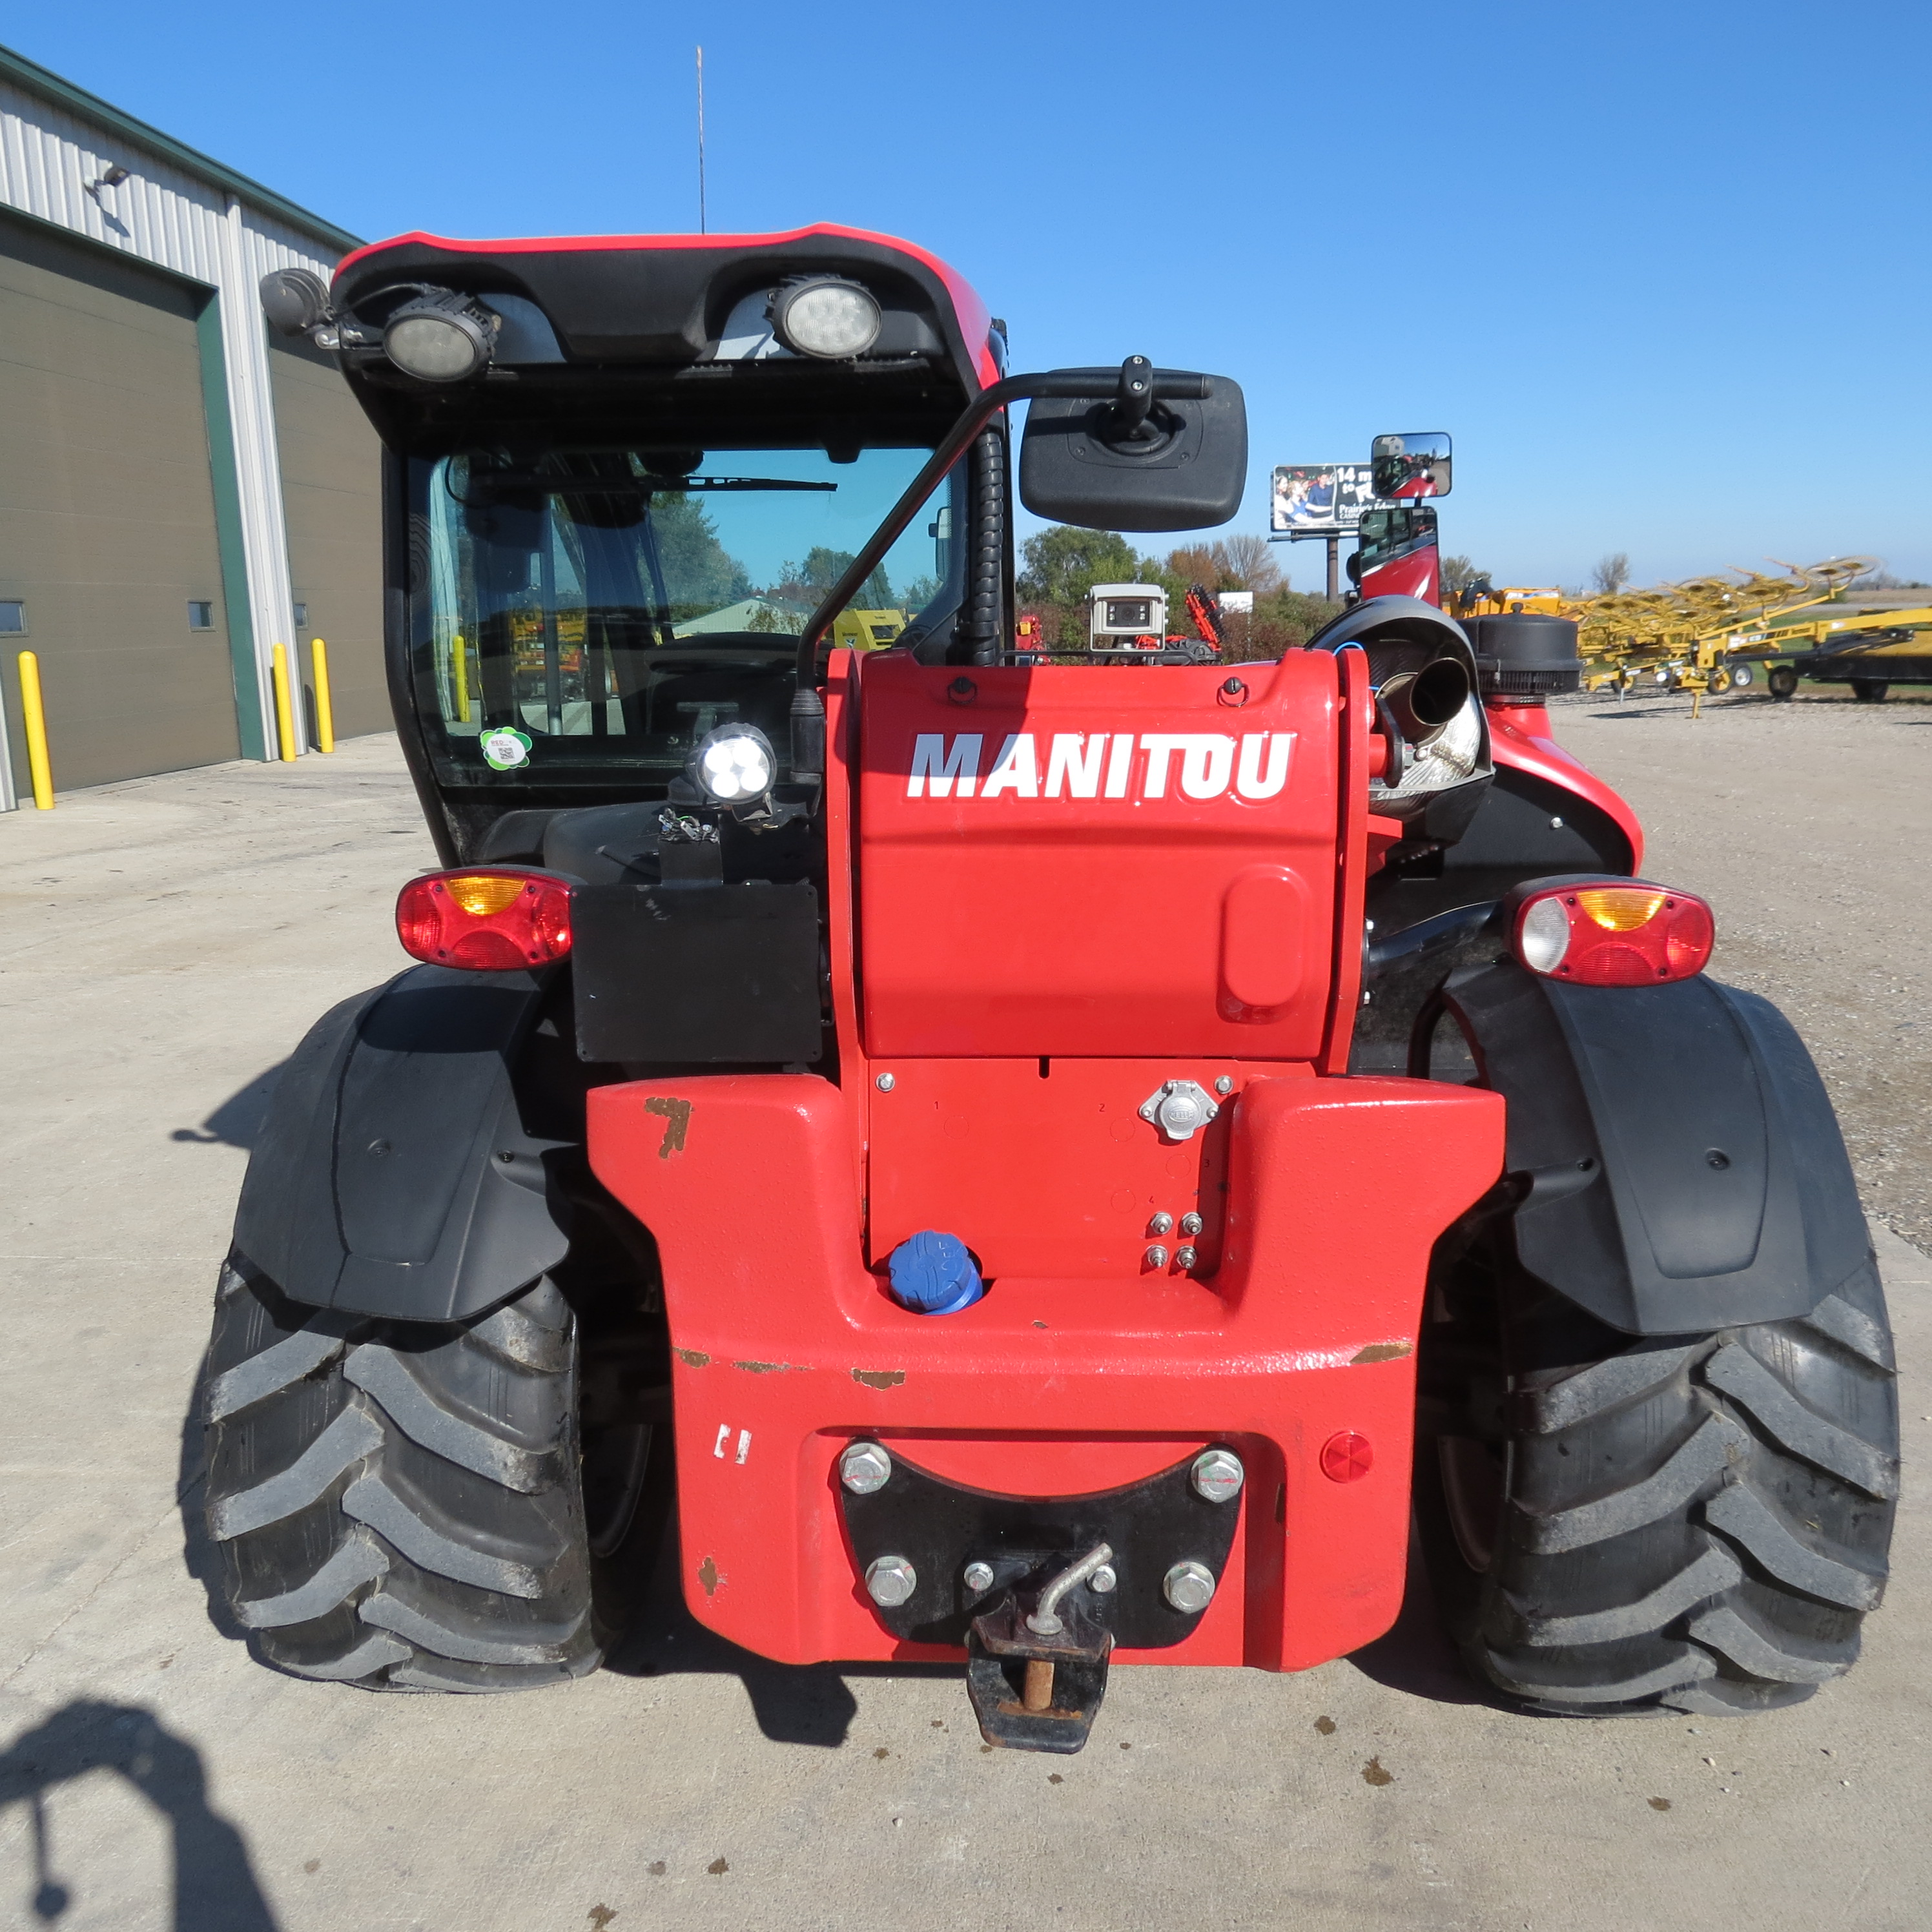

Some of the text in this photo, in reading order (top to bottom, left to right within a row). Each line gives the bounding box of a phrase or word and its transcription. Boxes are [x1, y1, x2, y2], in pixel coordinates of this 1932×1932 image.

[1337, 467, 1355, 482] 14
[1342, 483, 1355, 494] to
[906, 734, 1292, 799] MANITOU
[1099, 1103, 1105, 1112] 2
[1204, 1158, 1209, 1167] 3
